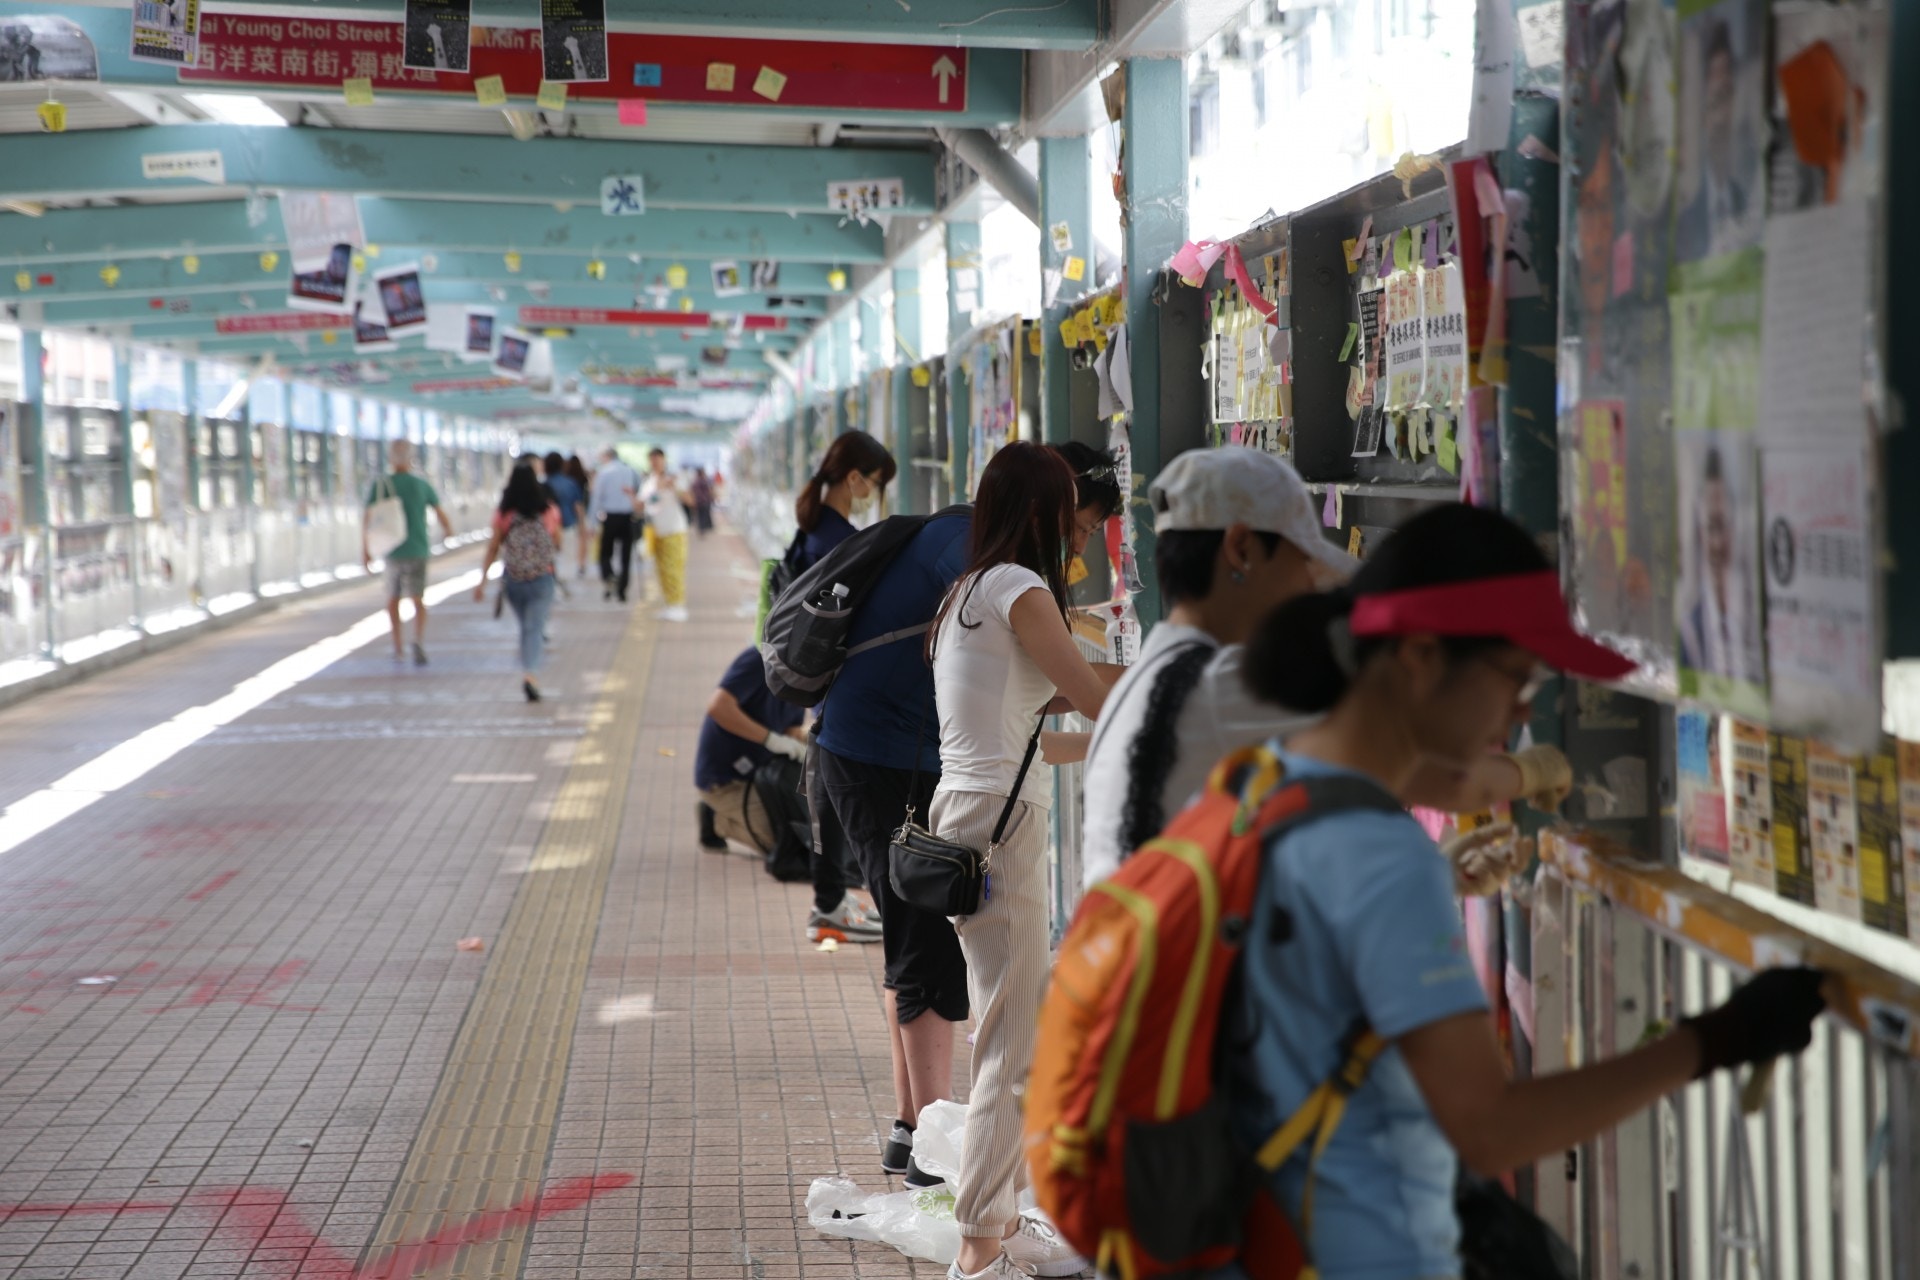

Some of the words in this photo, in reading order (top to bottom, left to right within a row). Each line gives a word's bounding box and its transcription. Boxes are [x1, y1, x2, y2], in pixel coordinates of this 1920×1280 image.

[201, 16, 218, 34] ai
[223, 18, 284, 41] Yeung
[288, 20, 332, 40] Choi
[336, 22, 391, 43] Street
[530, 31, 542, 50] R
